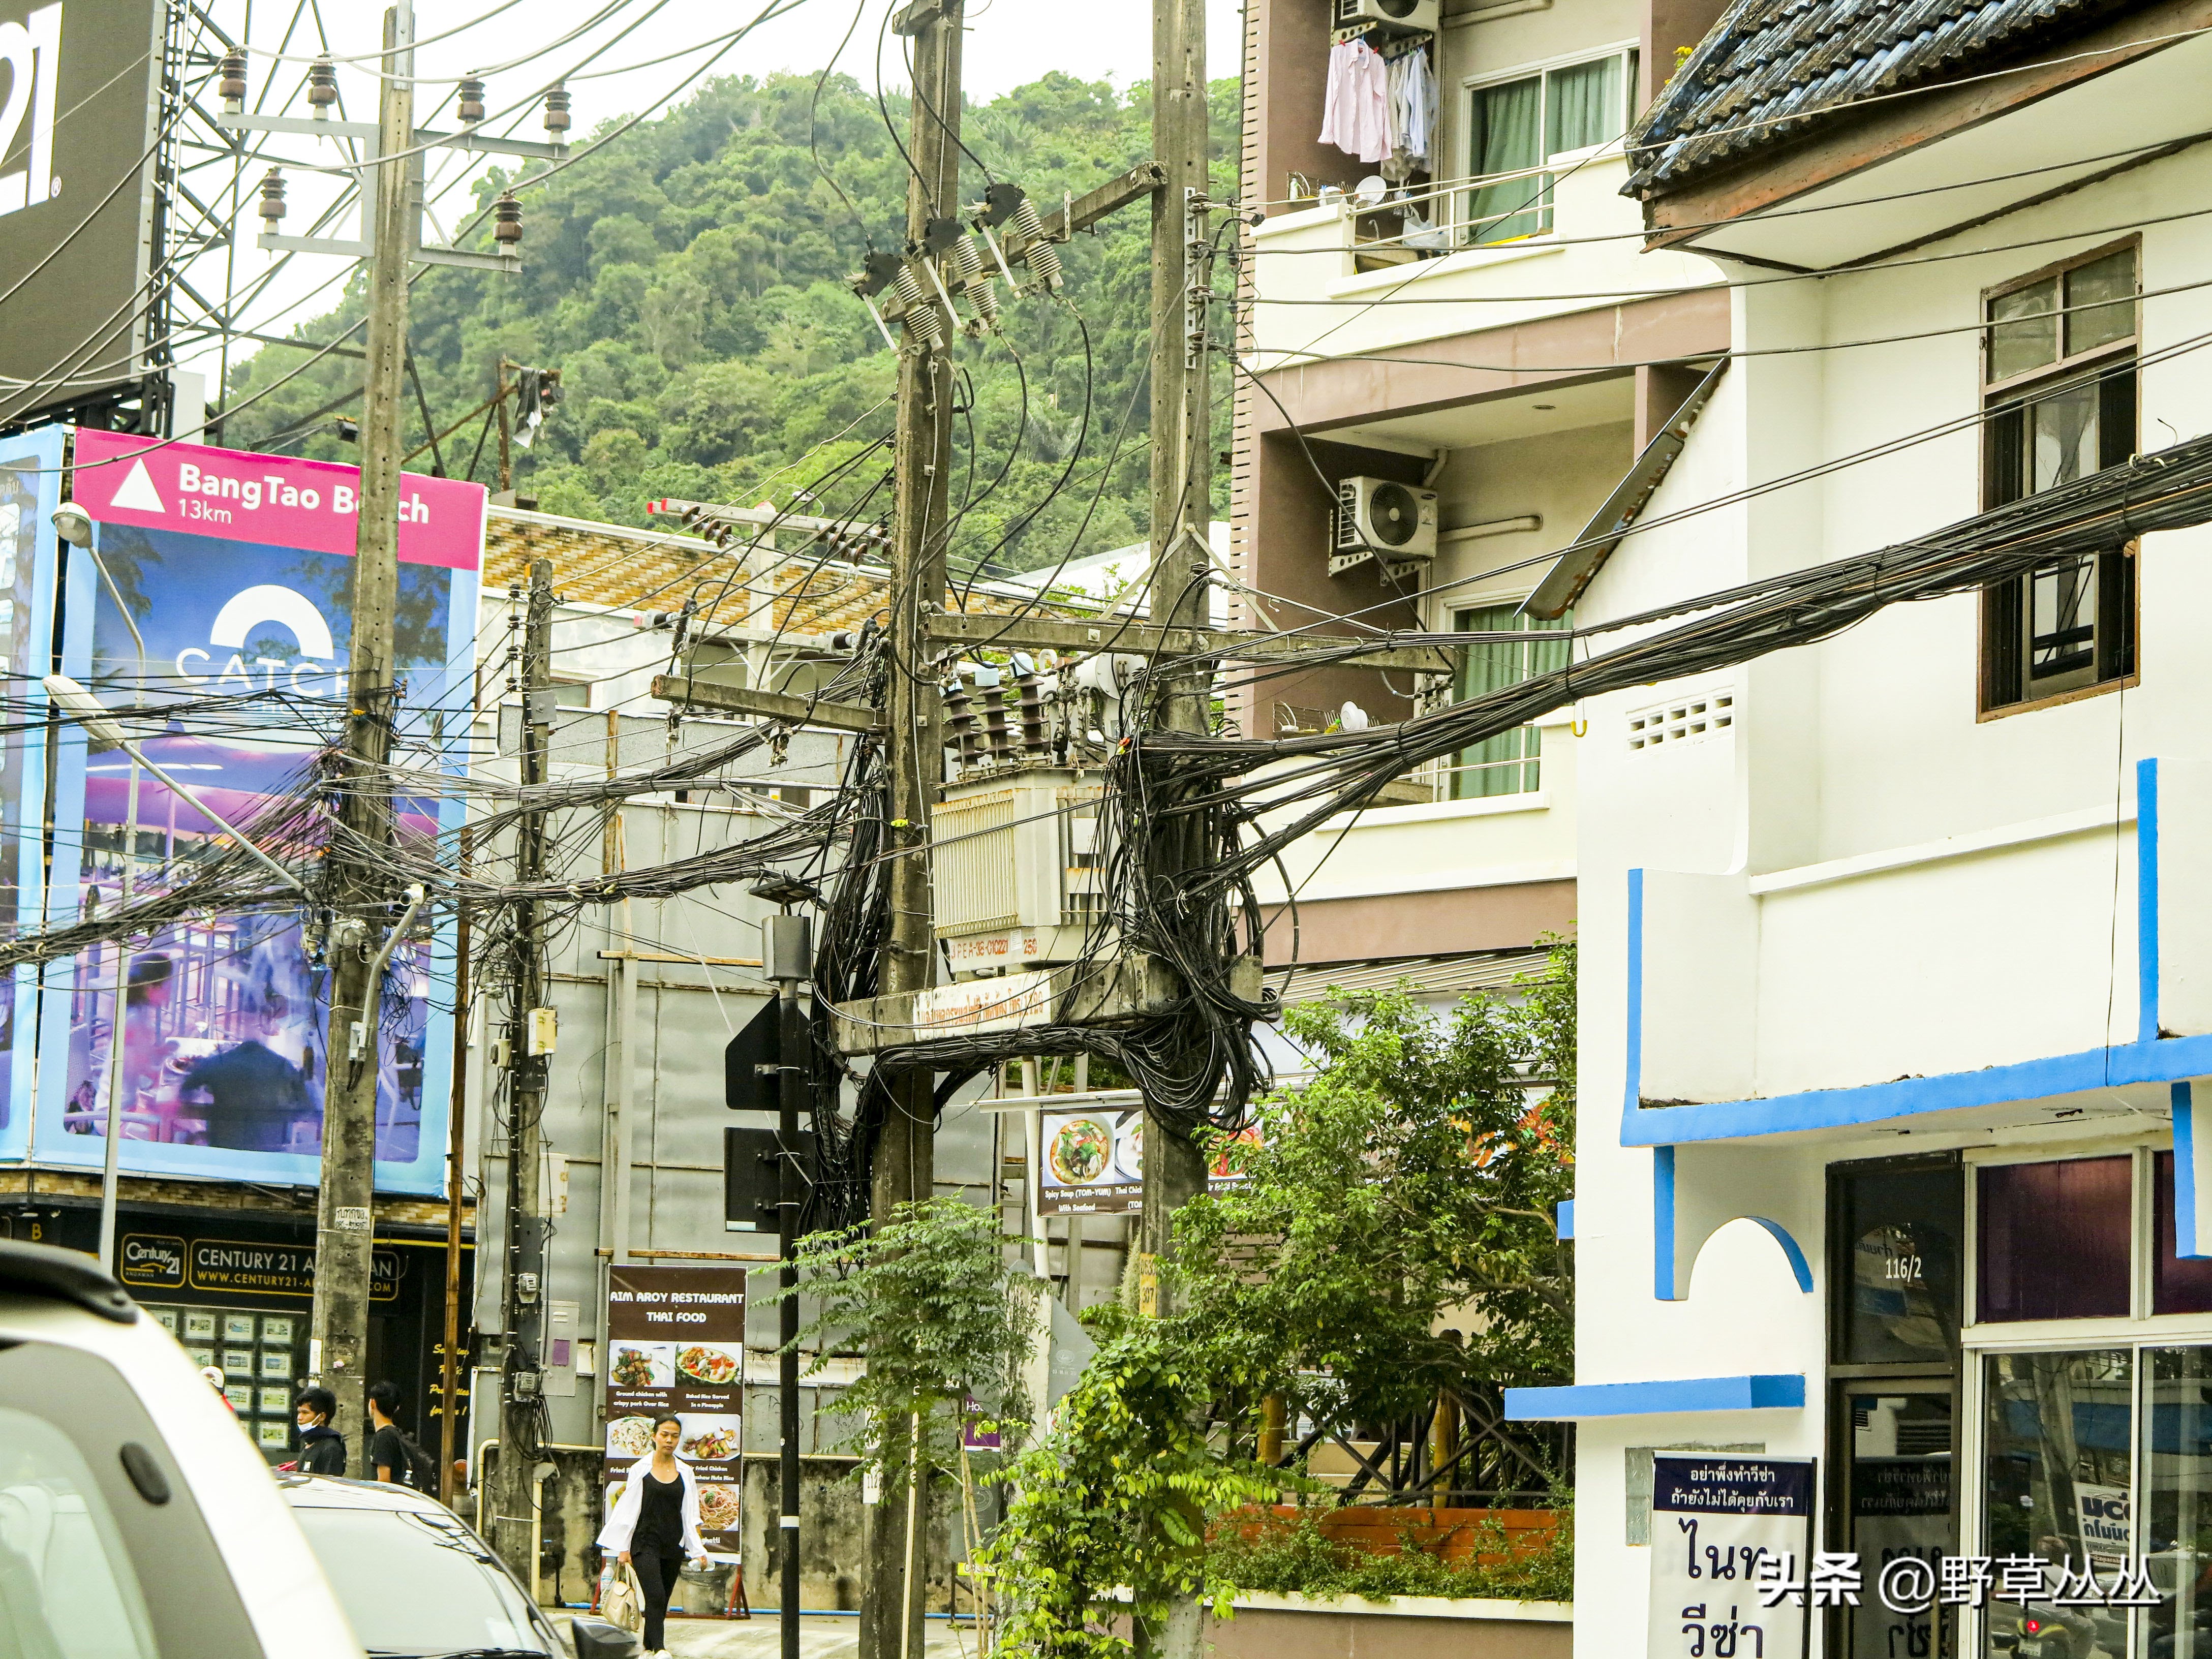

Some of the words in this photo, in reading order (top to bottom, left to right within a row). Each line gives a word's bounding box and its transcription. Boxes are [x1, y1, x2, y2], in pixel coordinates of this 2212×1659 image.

[179, 463, 321, 510] BangTao
[333, 484, 430, 524] Bch
[178, 498, 232, 525] 13km
[1045, 1190, 1059, 1200] Spicy
[1060, 1189, 1074, 1199] Soup
[1075, 1187, 1111, 1198] (TOM-YUM)
[1115, 1186, 1127, 1194] Thai
[1058, 1204, 1071, 1212] With
[1072, 1203, 1096, 1212] Seafood
[32, 1223, 42, 1240] B
[126, 1242, 172, 1263] Century
[166, 1256, 180, 1275] 21
[198, 1248, 273, 1270] CENTURY
[279, 1253, 296, 1271] 21
[1885, 1254, 1922, 1282] 116/2
[610, 1292, 634, 1302] AIM
[636, 1292, 668, 1303] AROY
[671, 1293, 744, 1304] RESTAURANT
[646, 1311, 673, 1323] THAI
[676, 1312, 707, 1323] FOOD
[1690, 1461, 1775, 1482] อย่าพึ่งทำวีซ่า
[1671, 1487, 1793, 1513] ถ้ายังไม่ได้คุยกับเรา
[1681, 1603, 1763, 1659] วีซ่า
